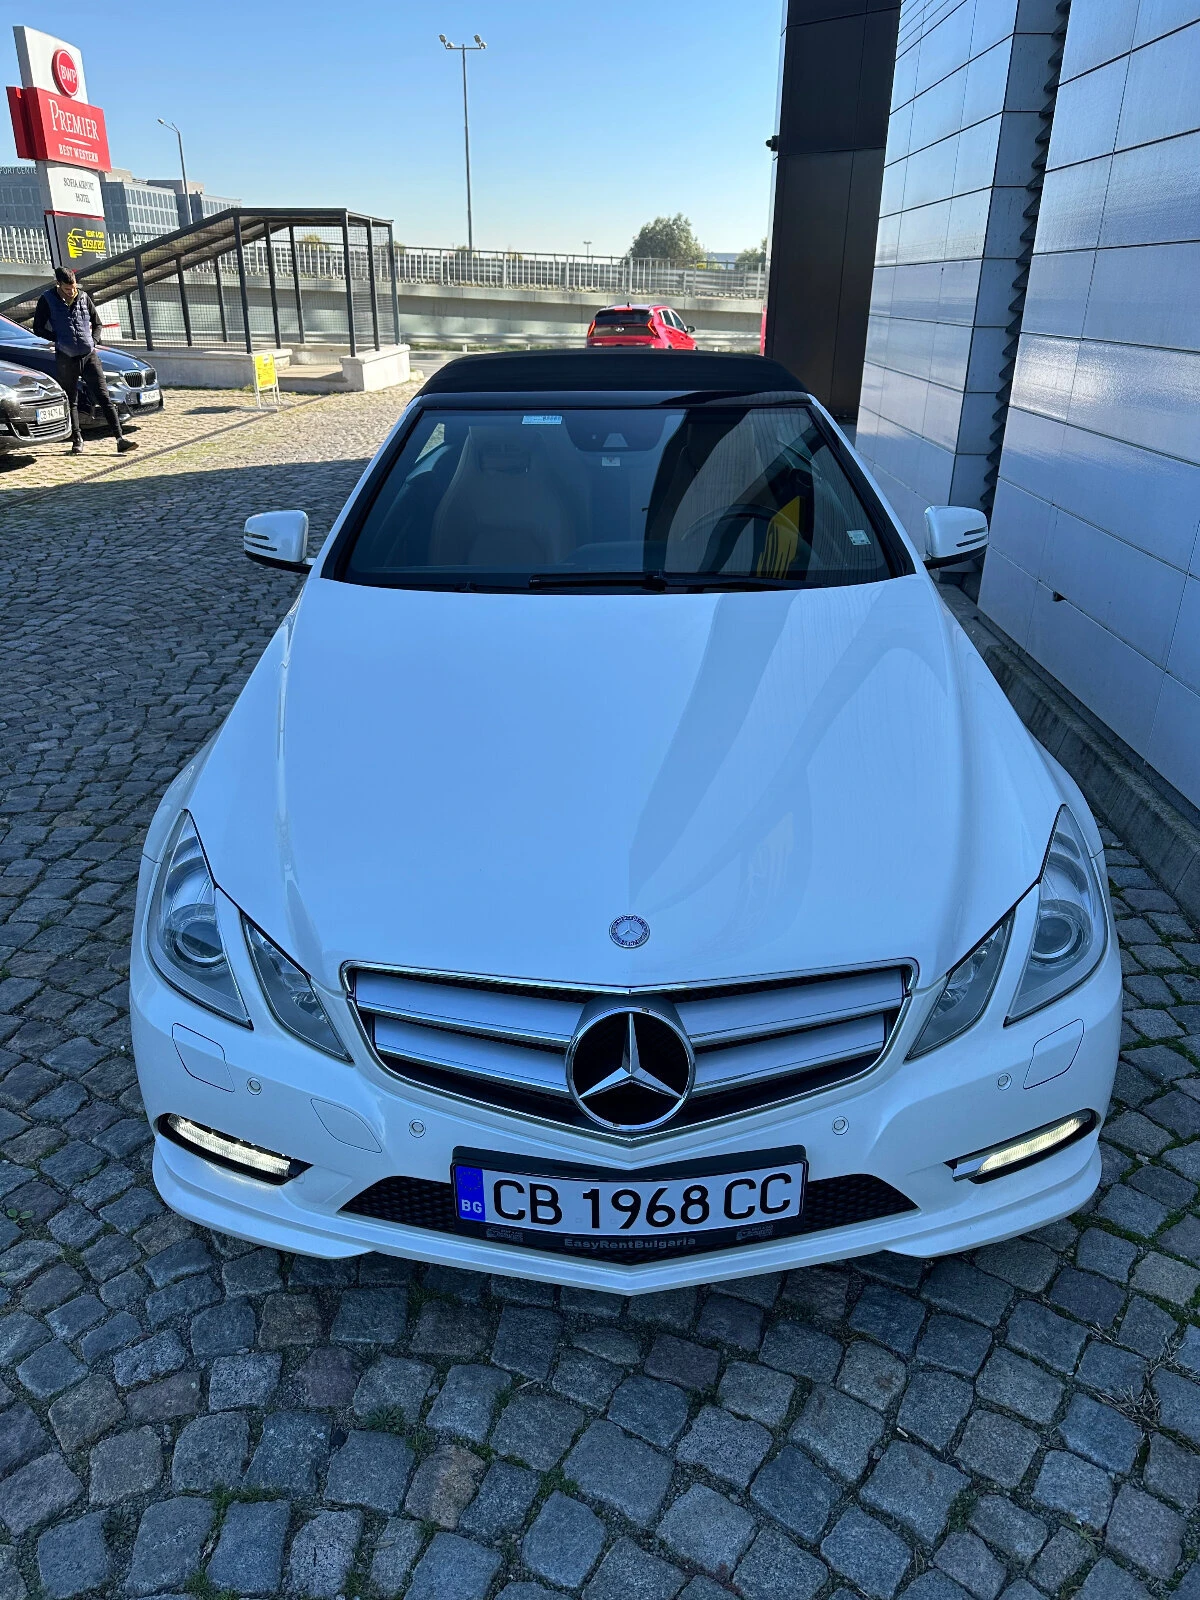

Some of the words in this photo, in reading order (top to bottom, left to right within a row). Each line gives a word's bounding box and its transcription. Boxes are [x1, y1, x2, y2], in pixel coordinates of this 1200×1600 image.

[59, 64, 77, 83] BWP
[58, 143, 73, 157] BEST
[73, 147, 99, 163] WESTERN
[461, 1199, 483, 1214] BG
[493, 1179, 563, 1226] CB
[582, 1184, 710, 1229] 1968
[723, 1172, 792, 1220] CC
[564, 1237, 696, 1250] EasyRentBulgaria
